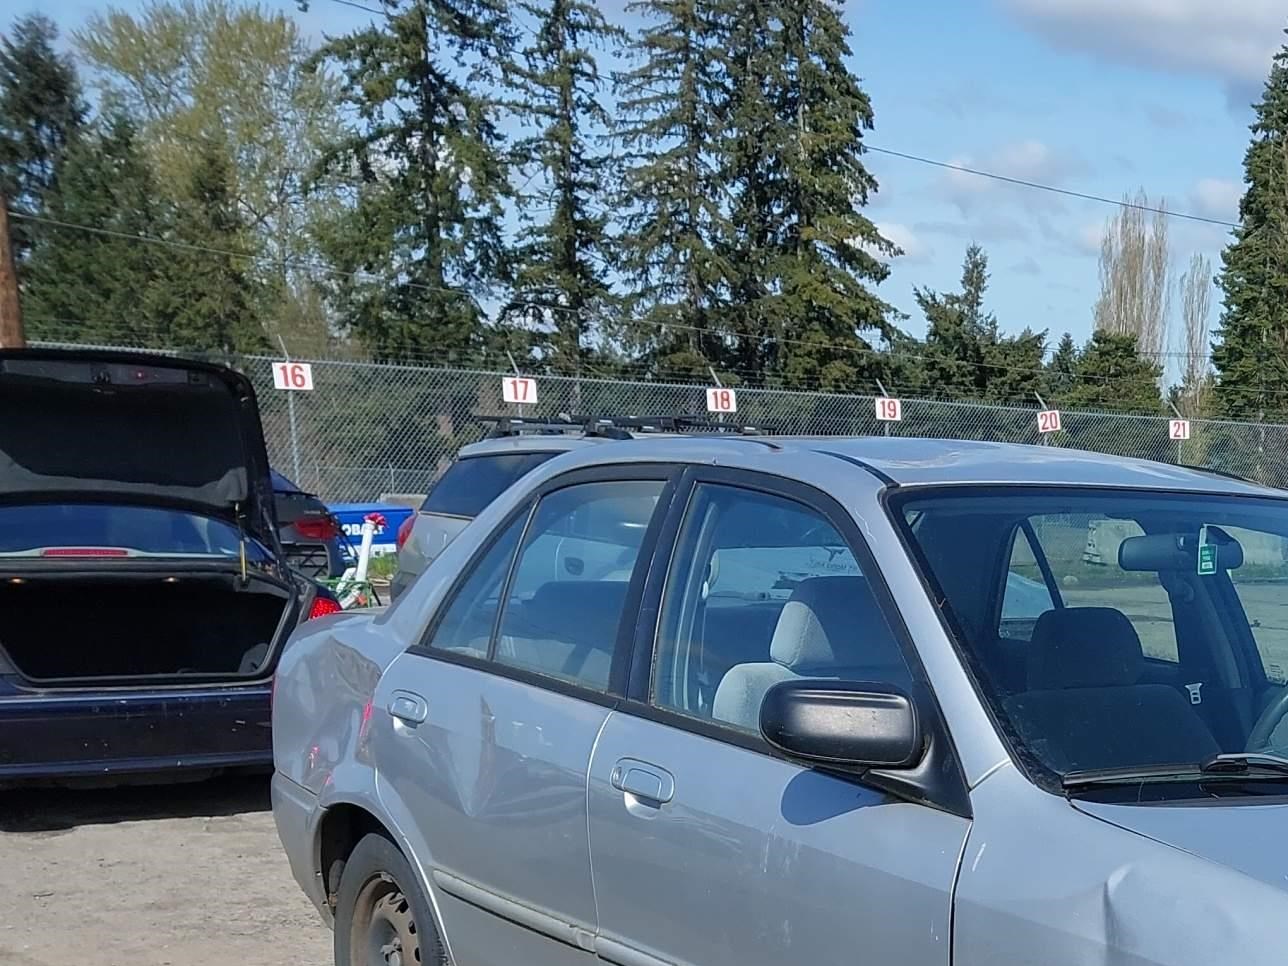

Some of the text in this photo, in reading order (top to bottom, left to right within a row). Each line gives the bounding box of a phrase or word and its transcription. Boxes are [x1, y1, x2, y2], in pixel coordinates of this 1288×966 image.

[279, 364, 306, 388] 16
[510, 379, 529, 401] 17
[711, 390, 731, 410] 18
[880, 400, 897, 419] 19
[1040, 412, 1058, 431] 20
[1173, 421, 1185, 438] 21
